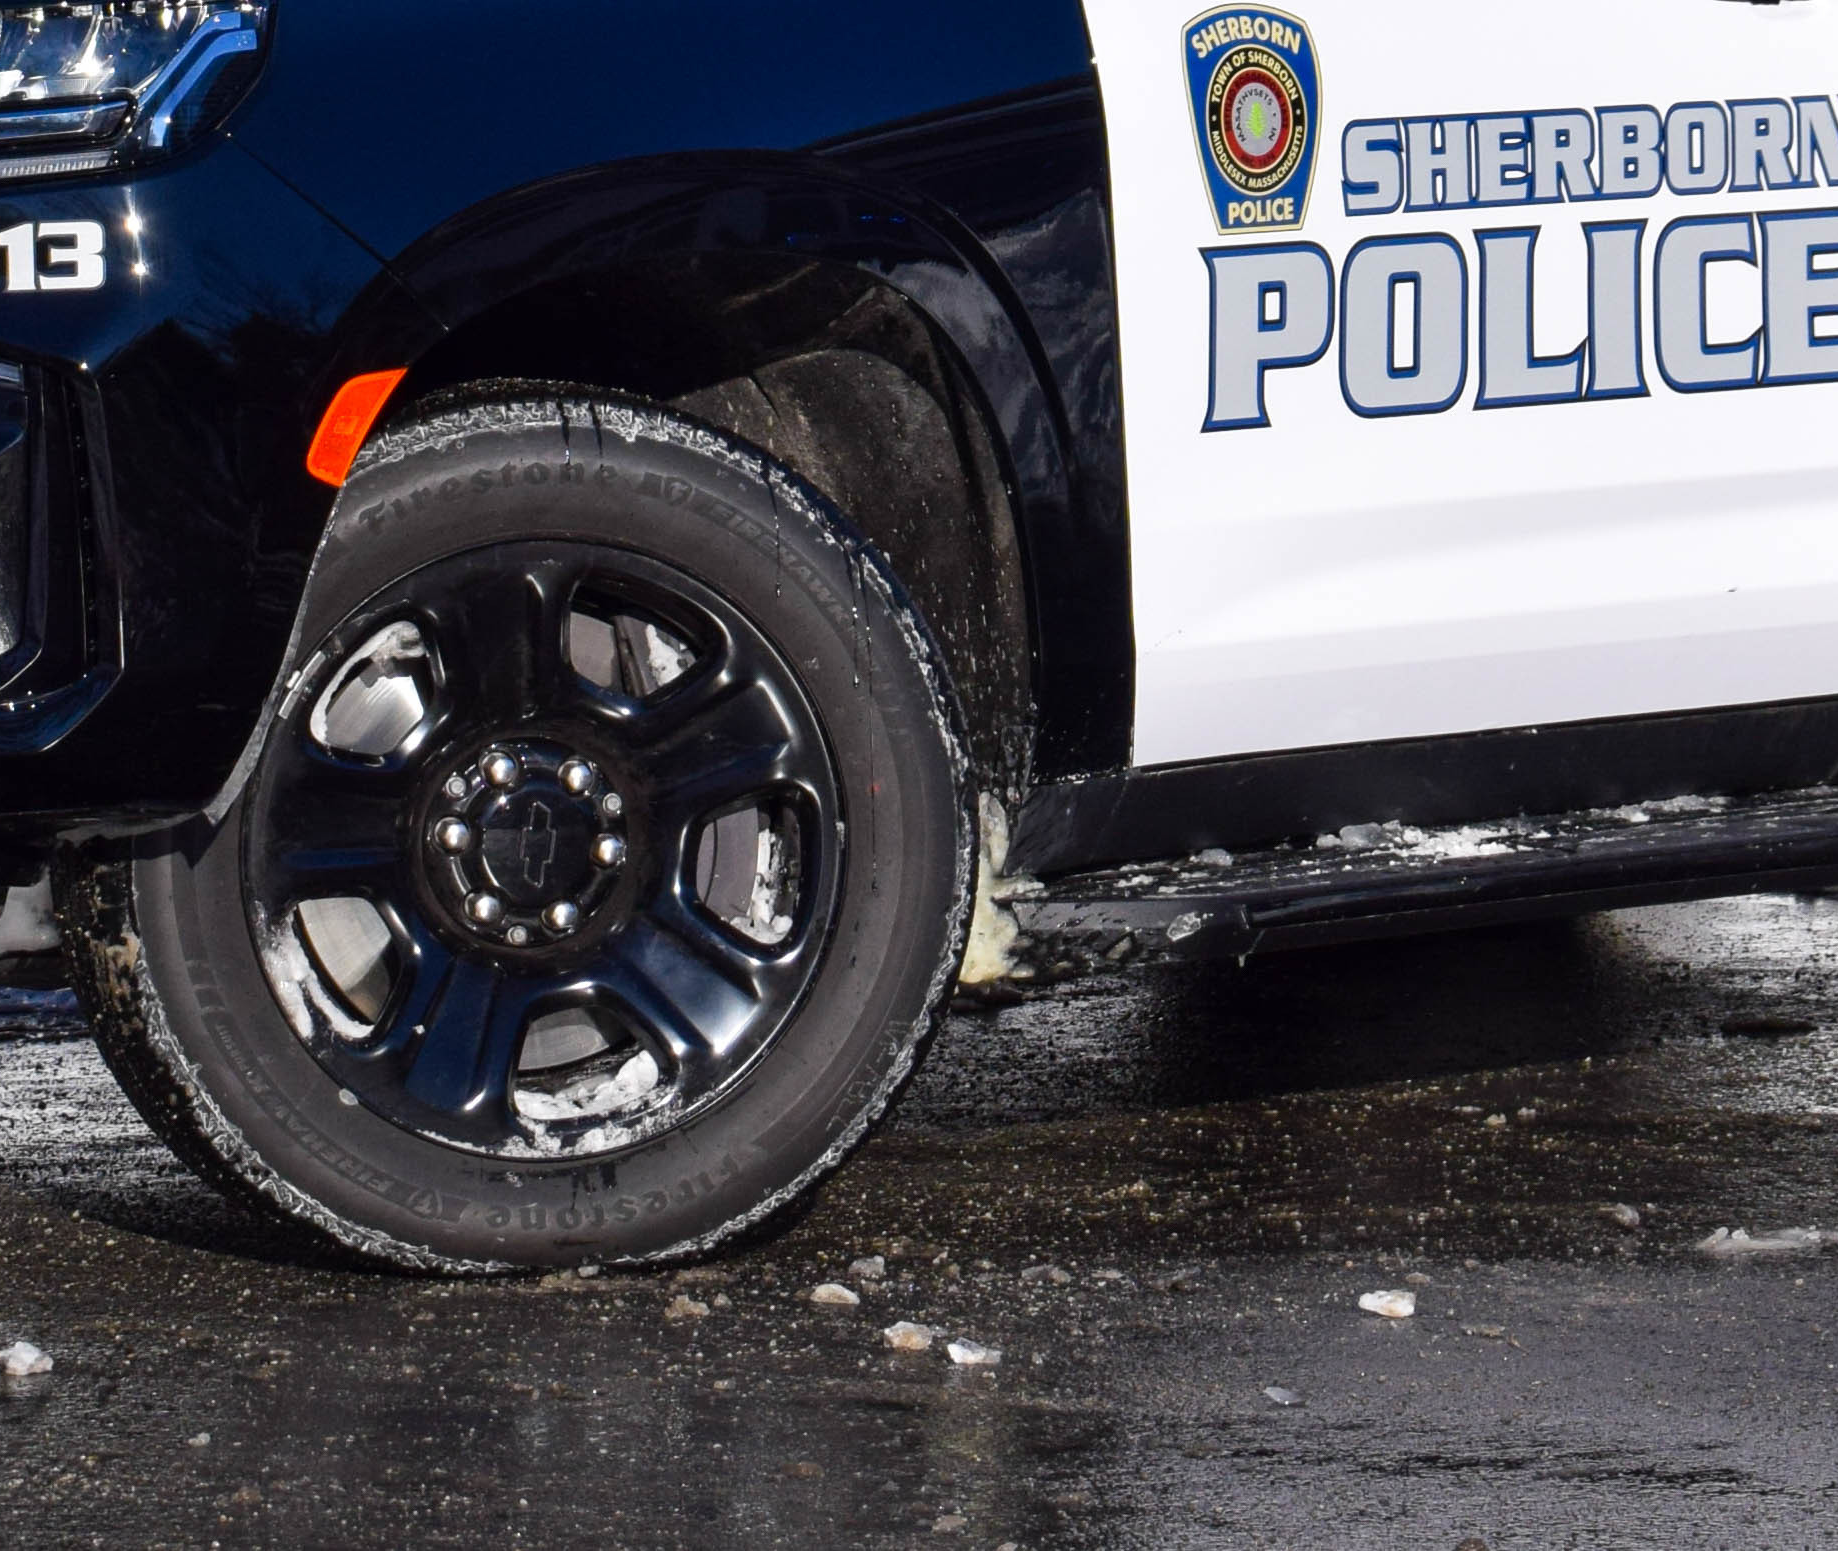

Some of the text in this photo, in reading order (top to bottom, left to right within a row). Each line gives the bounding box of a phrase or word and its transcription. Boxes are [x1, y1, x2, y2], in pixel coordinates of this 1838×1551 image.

[1192, 16, 1301, 58] SHERBORN
[1211, 50, 1299, 103] TOWN OF SHERBORN
[1211, 125, 1303, 188] MIDDLESEX MASSACHUSETTS
[1228, 197, 1295, 225] POLICE
